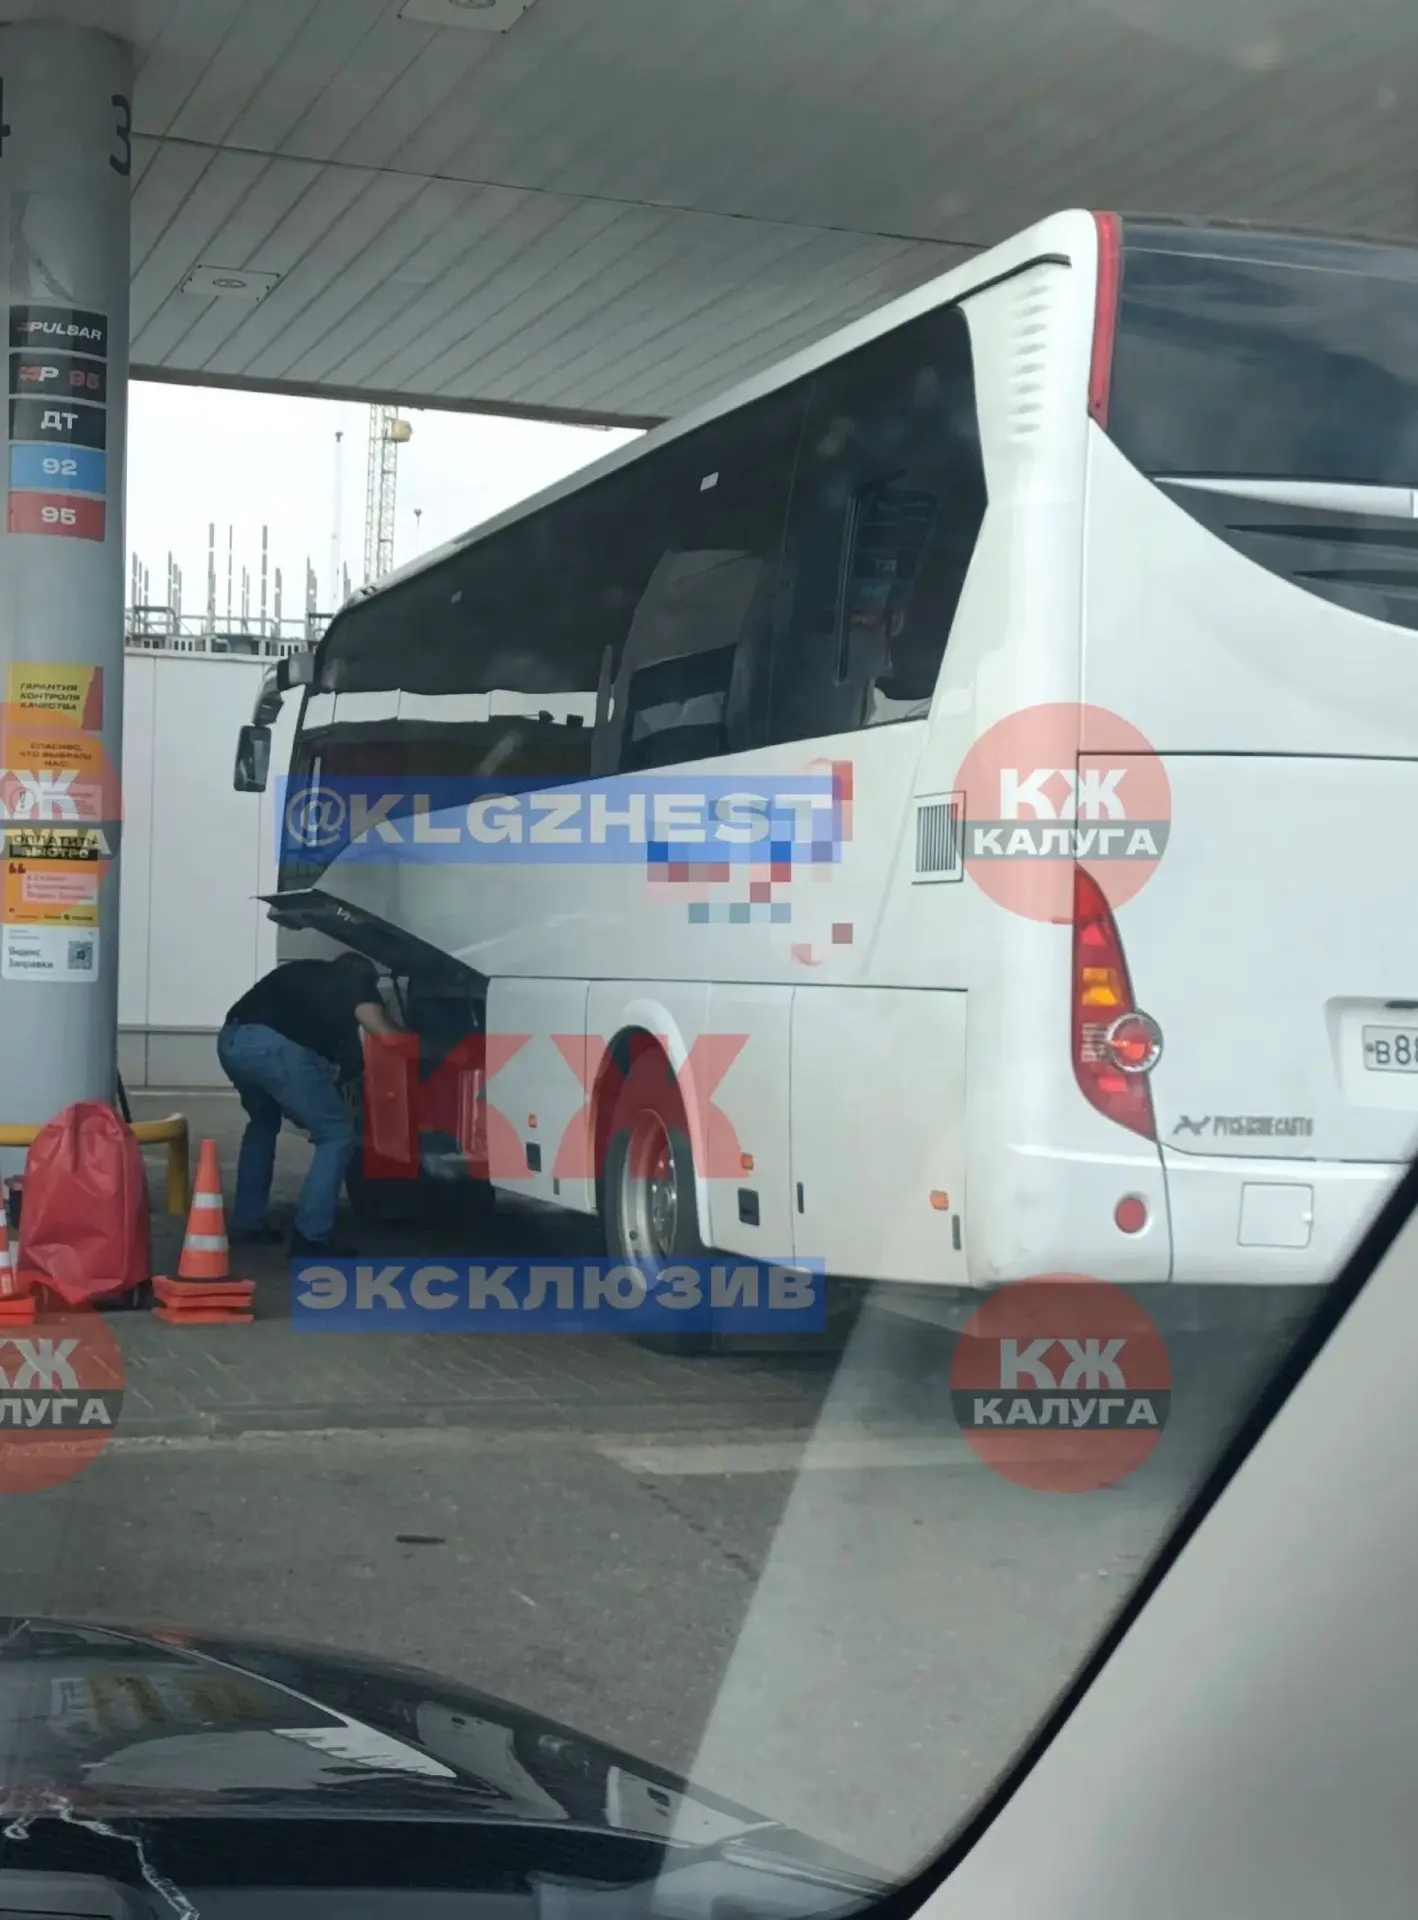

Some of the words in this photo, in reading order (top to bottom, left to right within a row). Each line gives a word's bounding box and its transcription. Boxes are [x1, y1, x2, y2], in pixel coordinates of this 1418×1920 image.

[28, 321, 102, 341] PULSAR
[41, 410, 78, 432] ДТ
[42, 457, 77, 476] 92
[41, 506, 76, 525] 95
[19, 692, 81, 701] КОНТРОЛЯ
[19, 701, 77, 711] КАЧЕСТВА
[1375, 1034, 1418, 1066] В8
